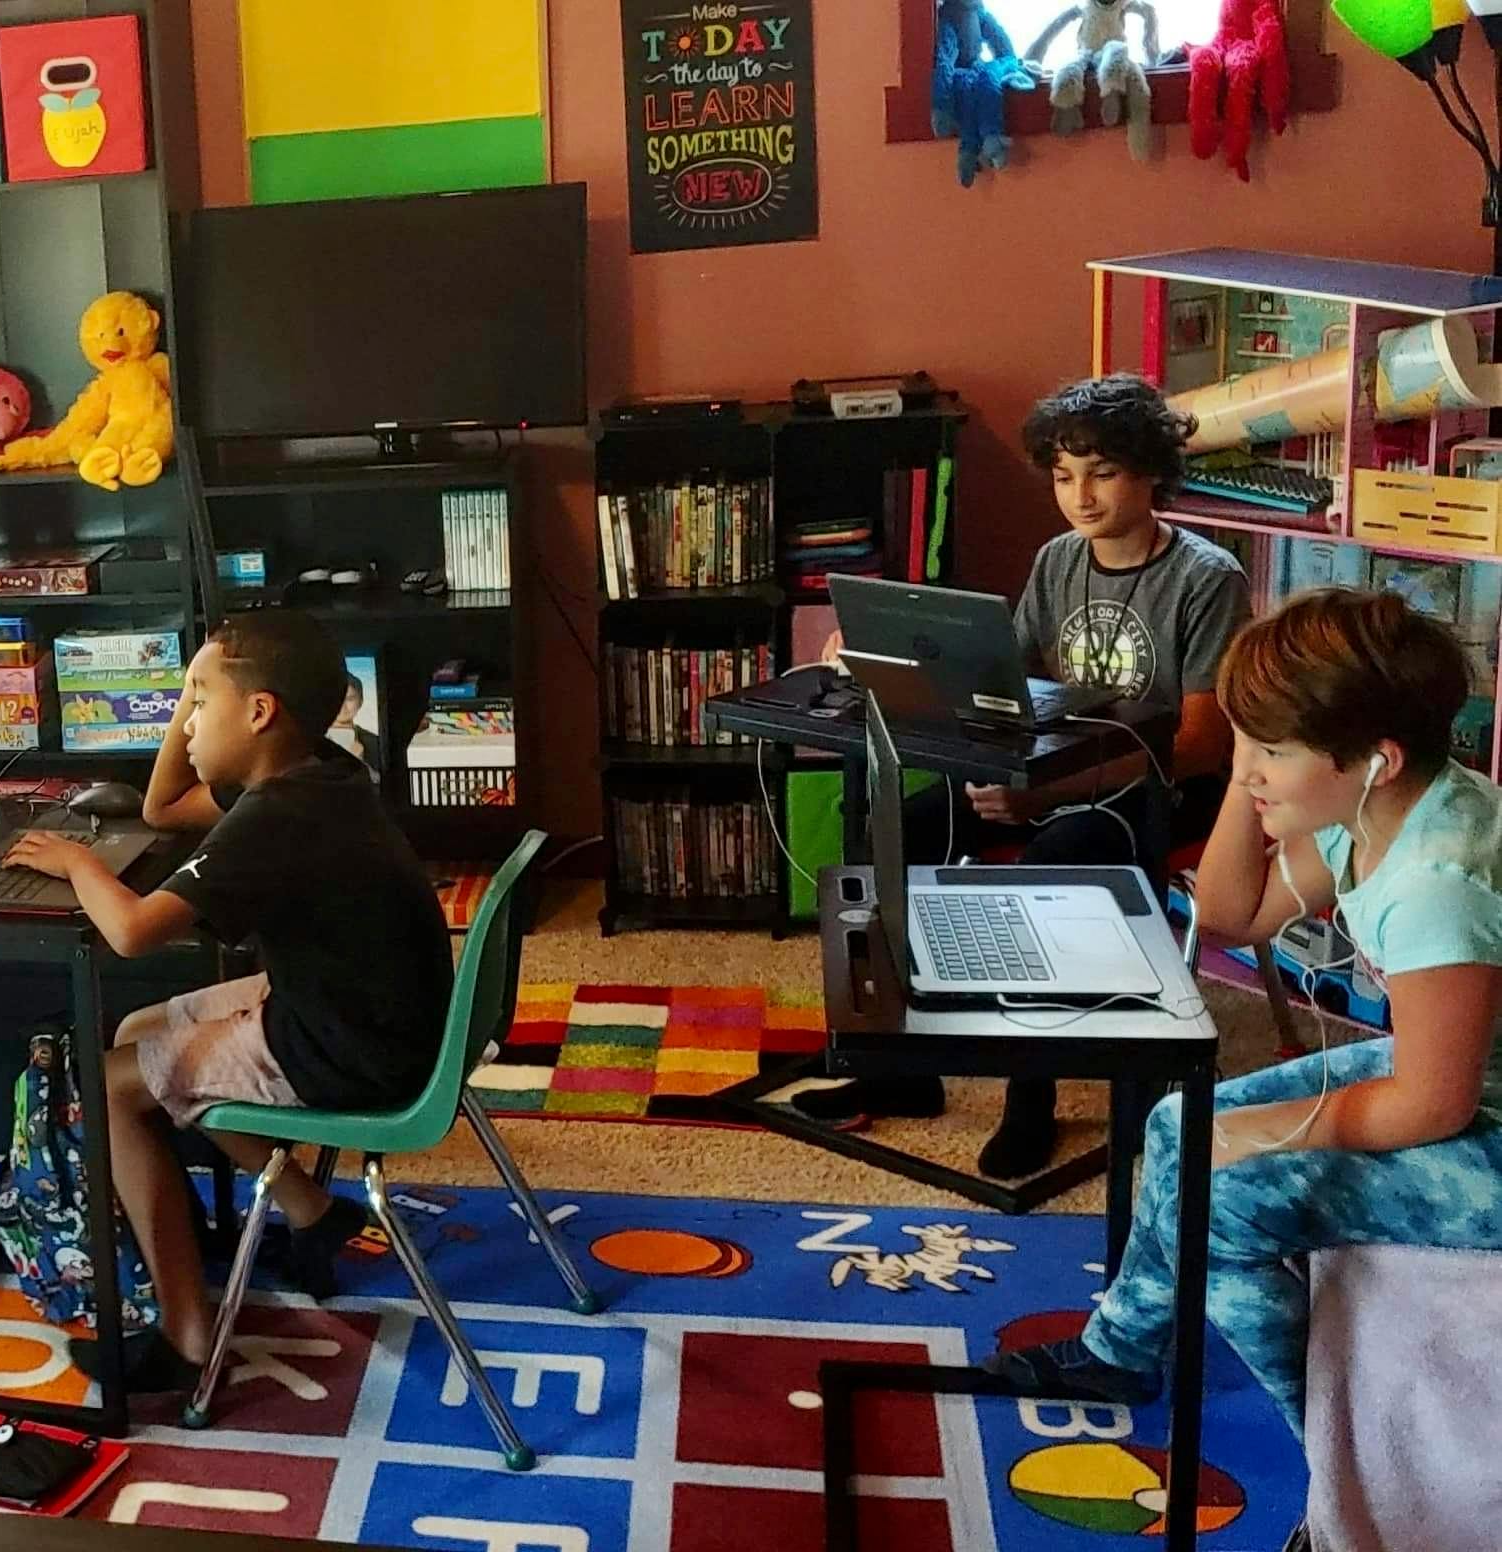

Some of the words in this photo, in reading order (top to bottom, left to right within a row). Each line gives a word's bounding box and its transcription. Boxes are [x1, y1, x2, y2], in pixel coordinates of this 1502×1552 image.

[692, 5, 738, 21] Make
[668, 62, 704, 85] the
[706, 60, 740, 88] day
[740, 57, 763, 78] to
[645, 81, 794, 131] LEARN
[648, 125, 795, 175] SOMETHING
[682, 169, 764, 203] NEW
[1126, 620, 1148, 658] CITY
[509, 1202, 581, 1244] Y
[441, 1349, 606, 1416] E
